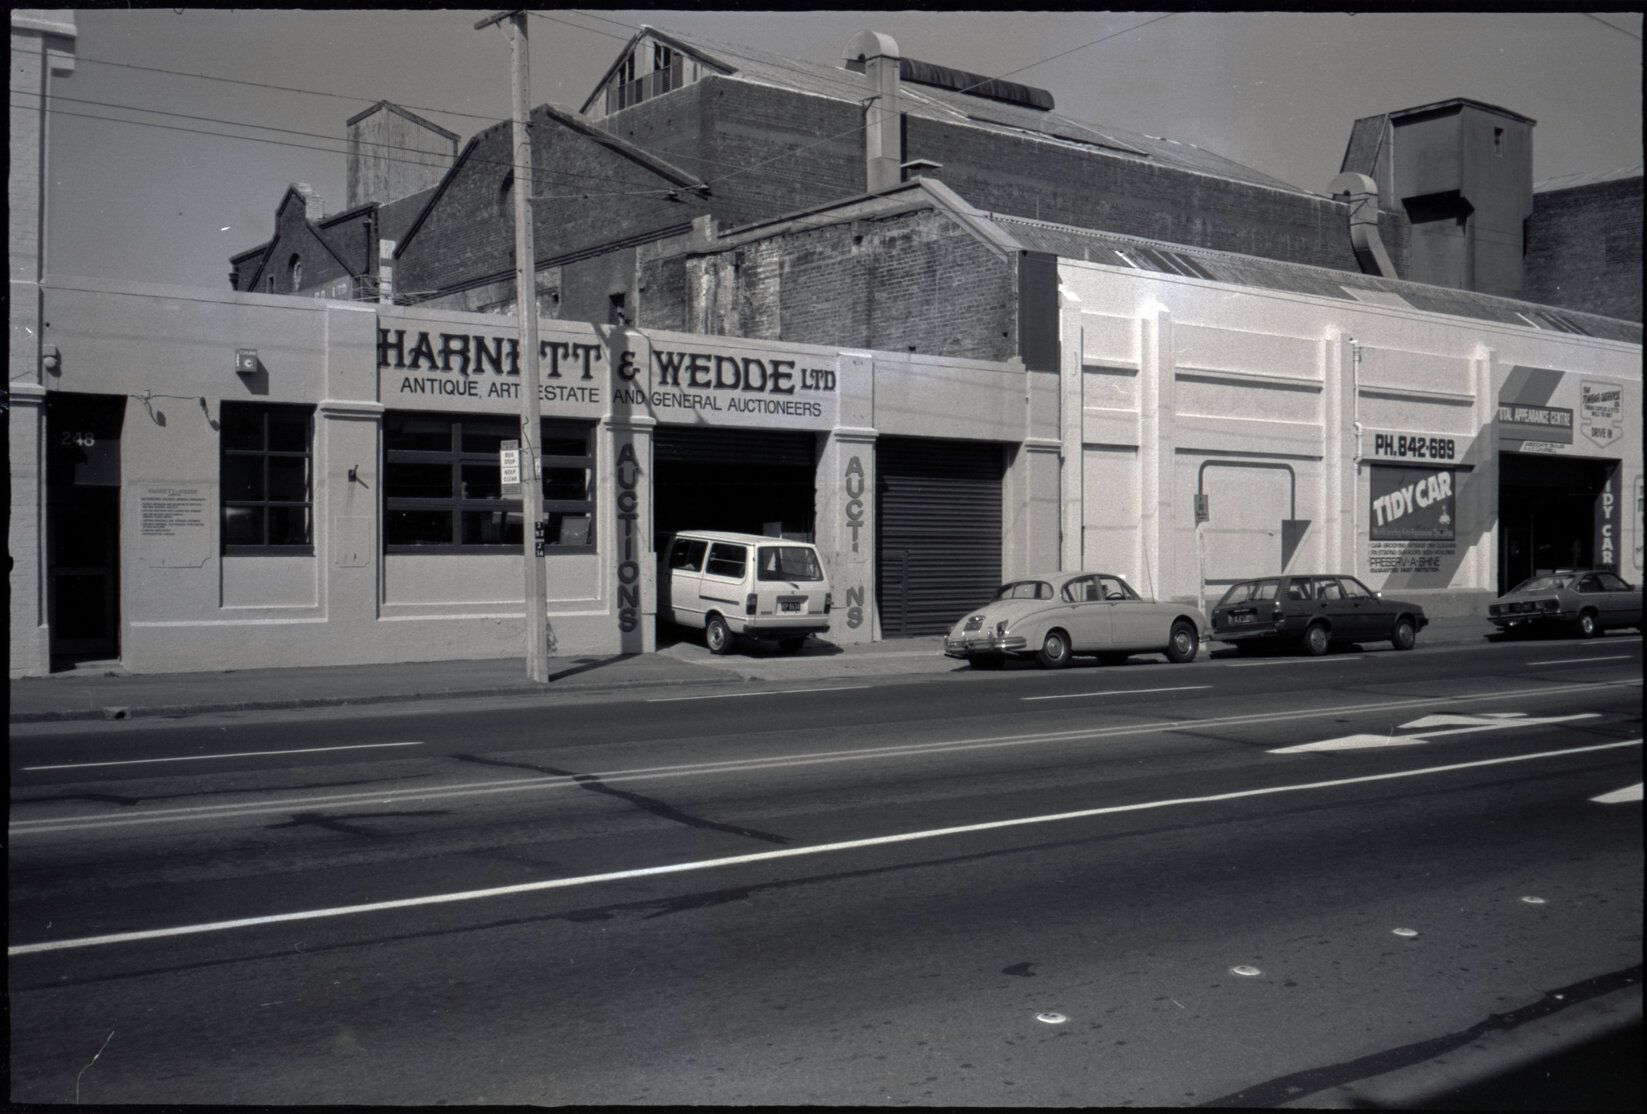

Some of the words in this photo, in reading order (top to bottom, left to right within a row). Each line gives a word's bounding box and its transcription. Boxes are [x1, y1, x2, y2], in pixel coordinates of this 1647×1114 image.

[617, 350, 641, 382] &
[652, 350, 796, 396] WEDDE
[801, 368, 837, 392] LTD
[400, 376, 483, 400] ANTIQUE,
[612, 389, 646, 406] AND
[651, 391, 723, 412] GENERAL
[727, 397, 822, 418] AUCTIONEERS
[61, 431, 95, 447] 248
[1550, 410, 1571, 427] CENTRE
[1373, 484, 1414, 527] TIDY
[1415, 471, 1453, 508] CAR
[617, 442, 640, 632] AUCTIONS
[1602, 524, 1614, 564] CAR
